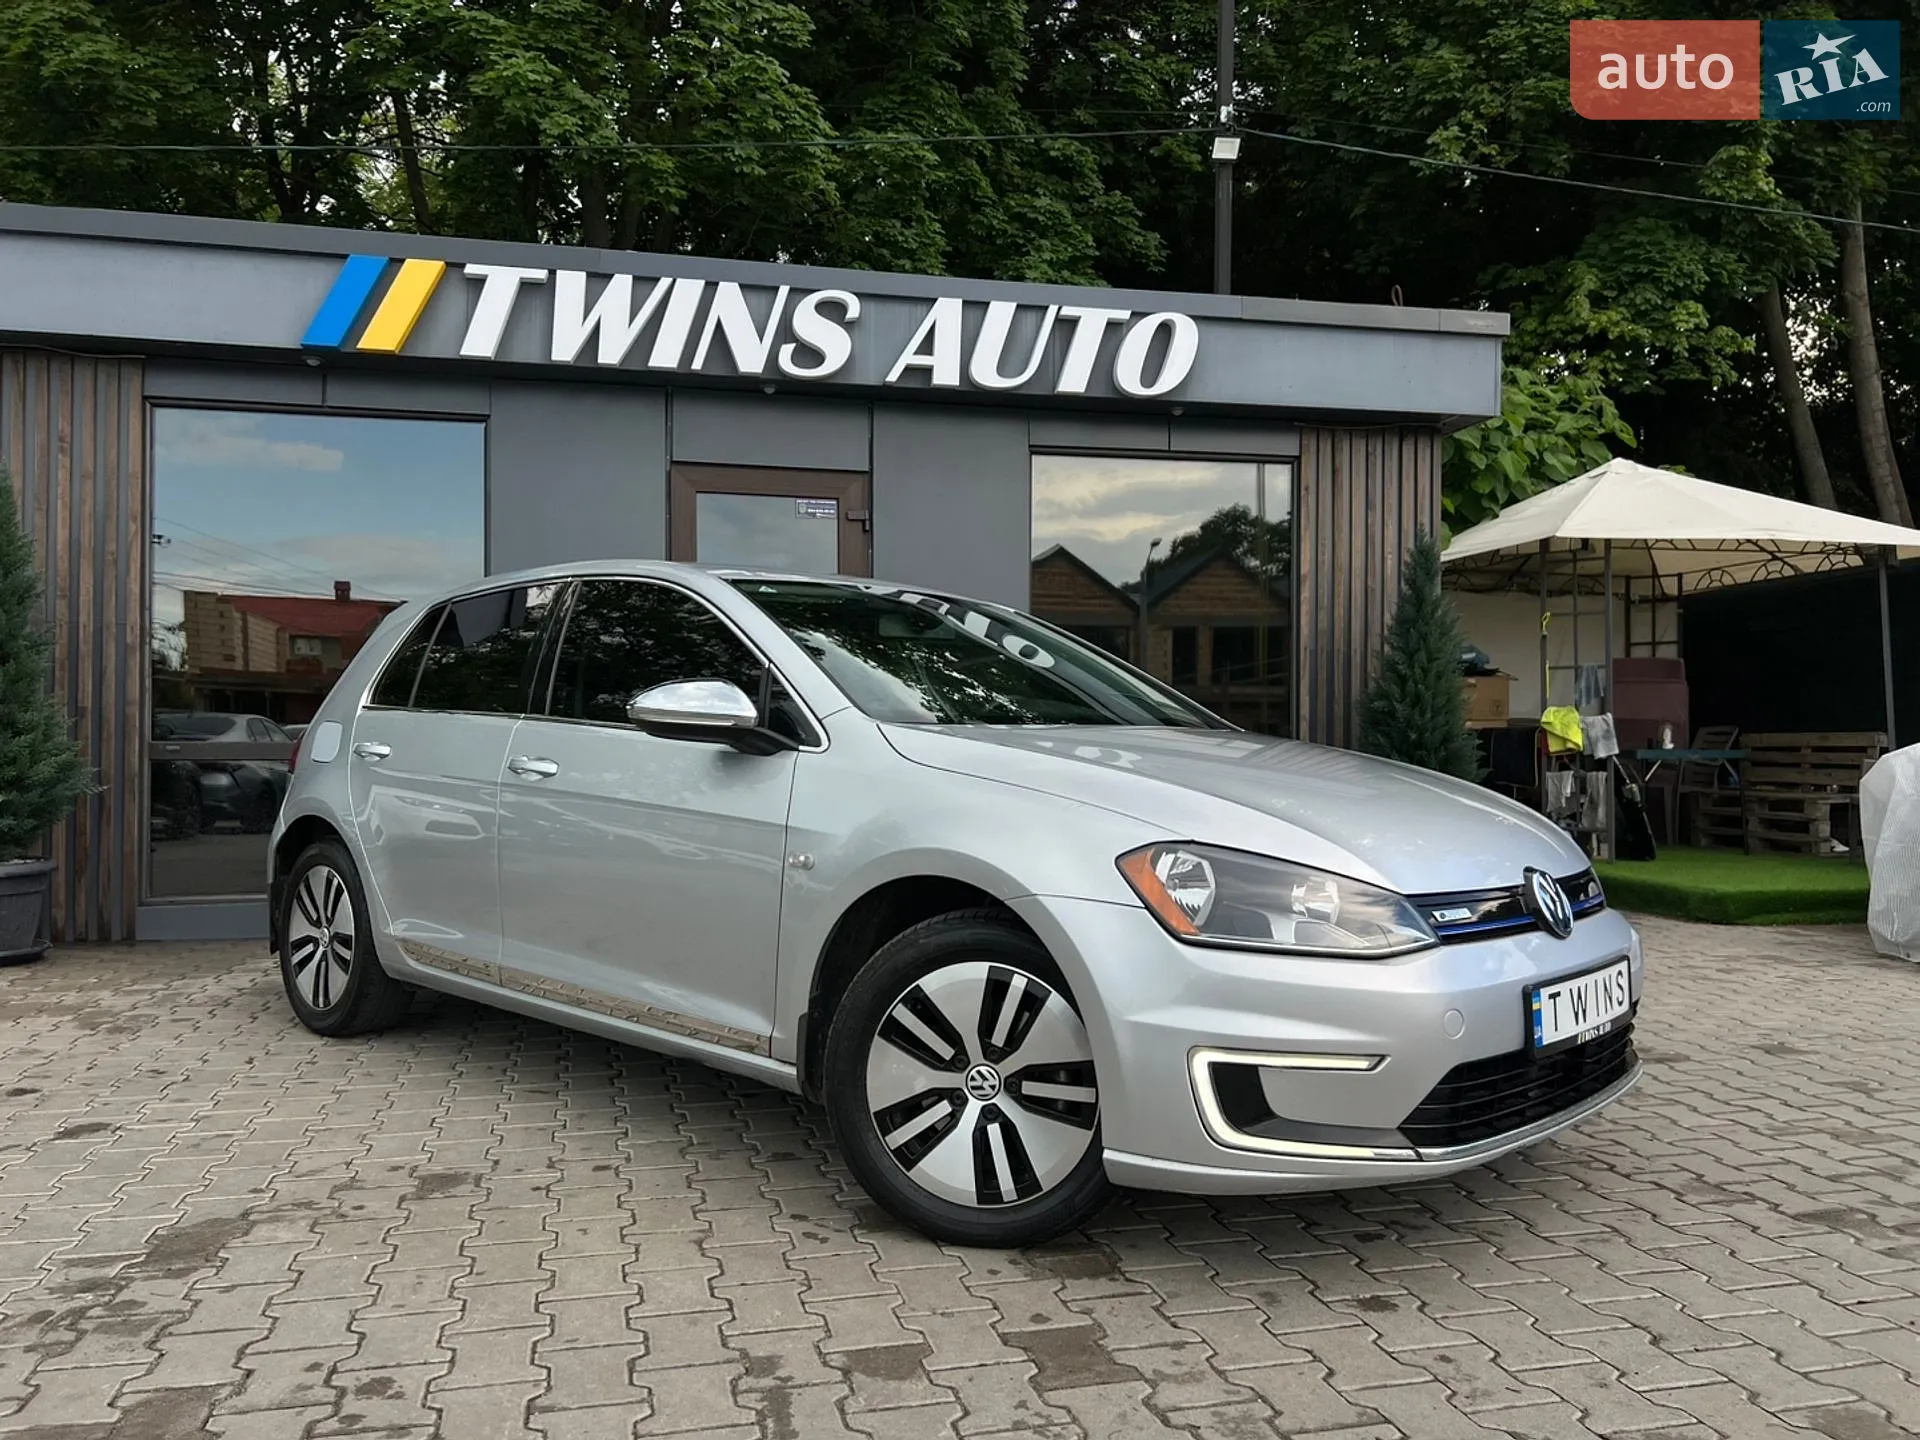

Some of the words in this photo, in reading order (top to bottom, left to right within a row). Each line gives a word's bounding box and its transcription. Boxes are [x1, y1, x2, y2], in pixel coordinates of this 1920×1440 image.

[459, 263, 862, 380] TWINS
[884, 296, 1200, 398] AUTO
[1548, 969, 1625, 1033] TWINS
